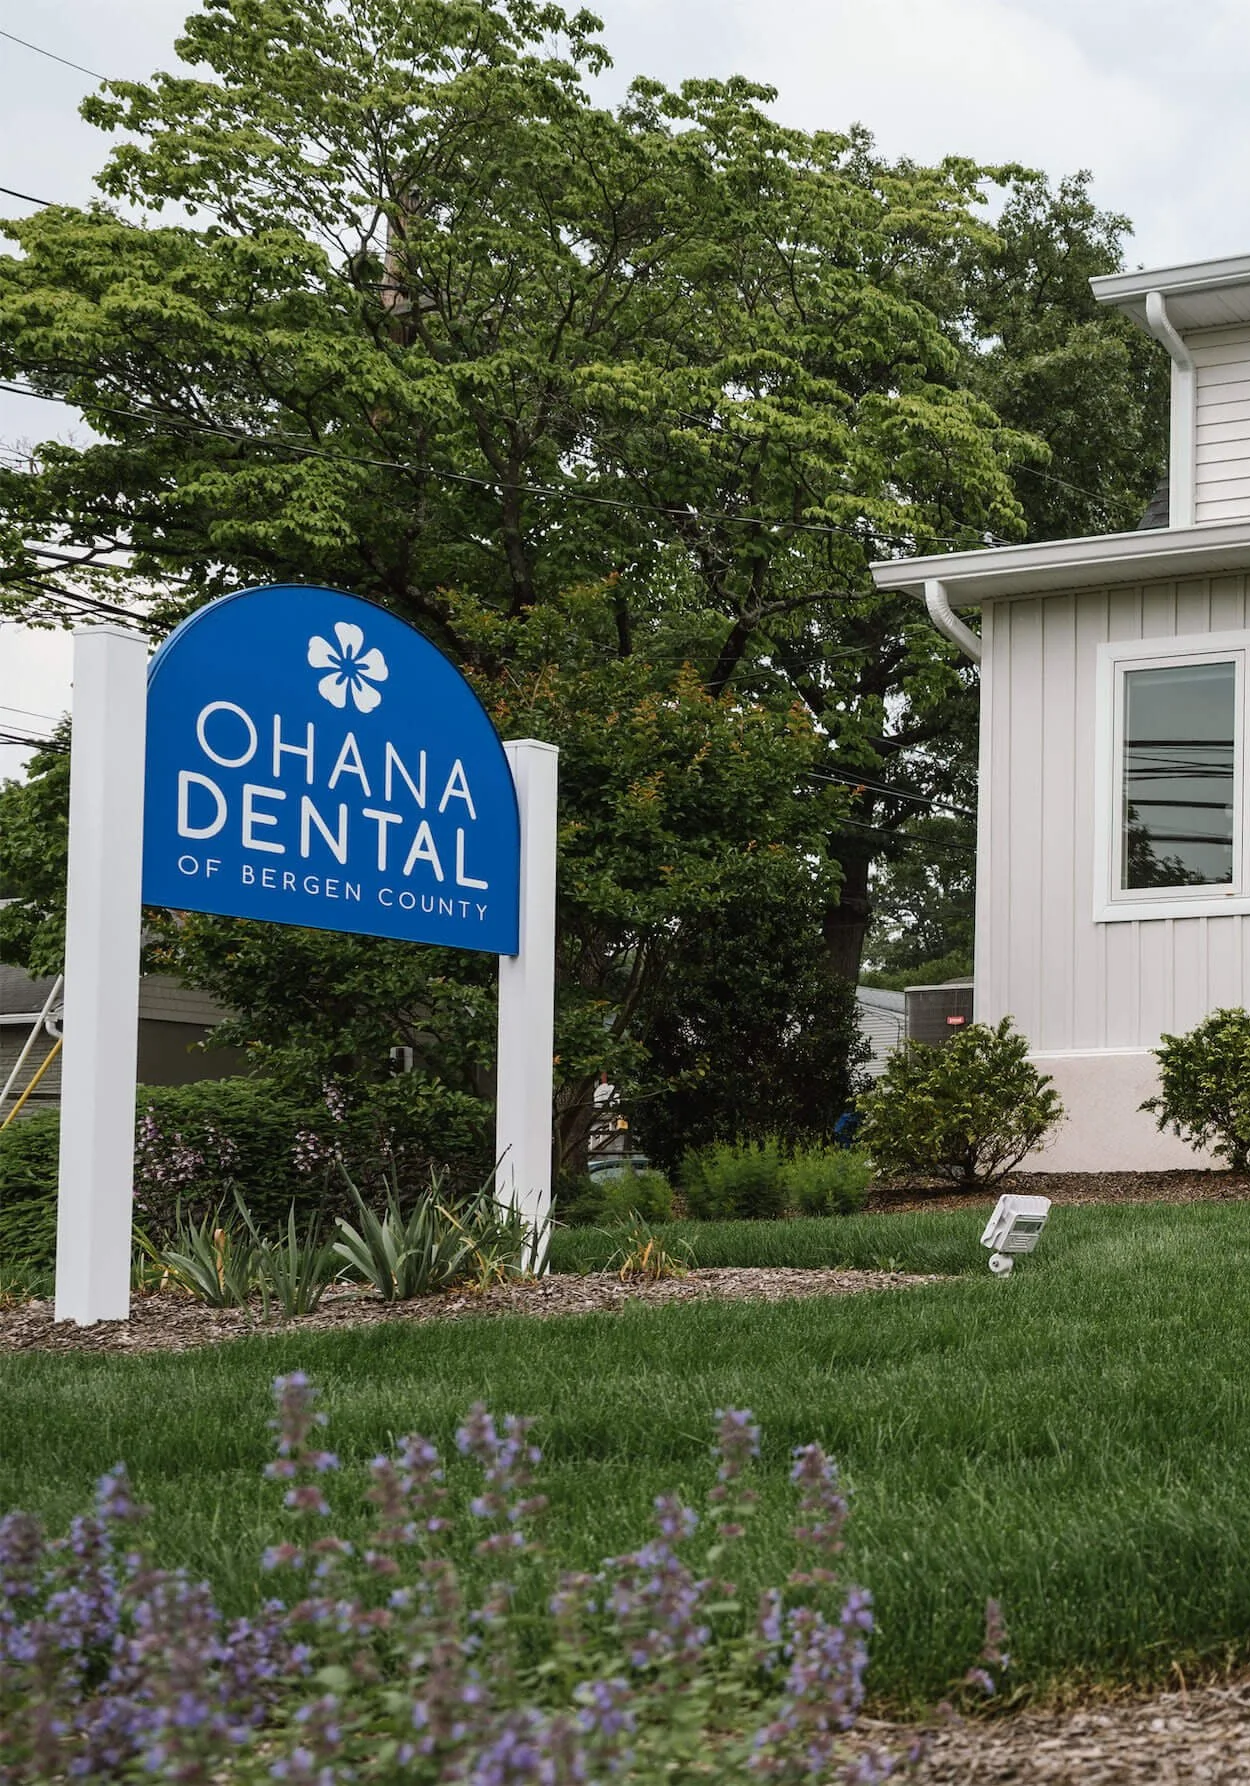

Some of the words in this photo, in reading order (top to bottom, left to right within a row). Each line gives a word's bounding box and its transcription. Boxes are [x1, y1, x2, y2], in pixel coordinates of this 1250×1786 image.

[196, 700, 477, 820] OHANA
[177, 770, 489, 890] DENTAL
[178, 855, 221, 879] OF
[242, 864, 361, 902] BERGEN
[378, 888, 488, 921] COUNTY
